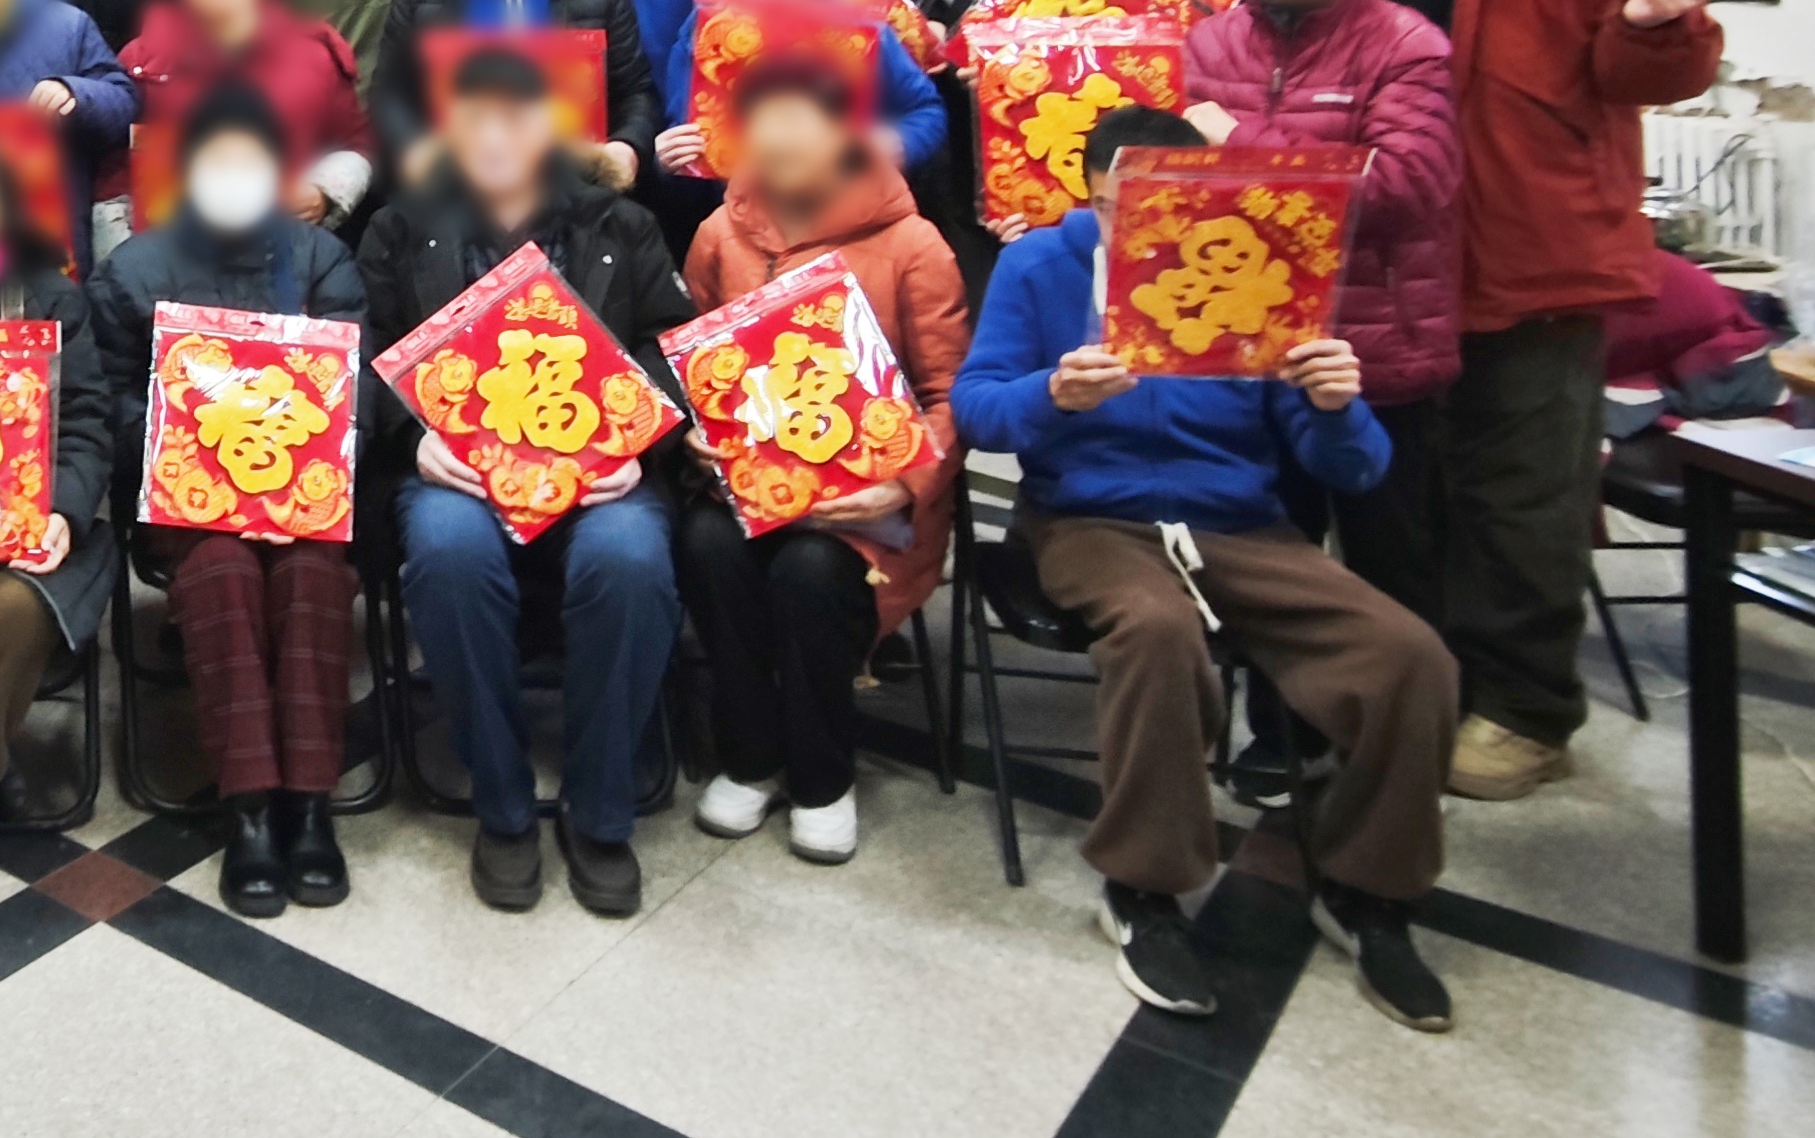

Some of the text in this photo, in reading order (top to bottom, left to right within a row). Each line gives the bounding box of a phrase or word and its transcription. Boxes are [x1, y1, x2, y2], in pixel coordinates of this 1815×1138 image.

[1130, 215, 1294, 355] 福
[194, 364, 330, 494] 福
[477, 329, 600, 454] 福
[734, 331, 857, 464] 福
